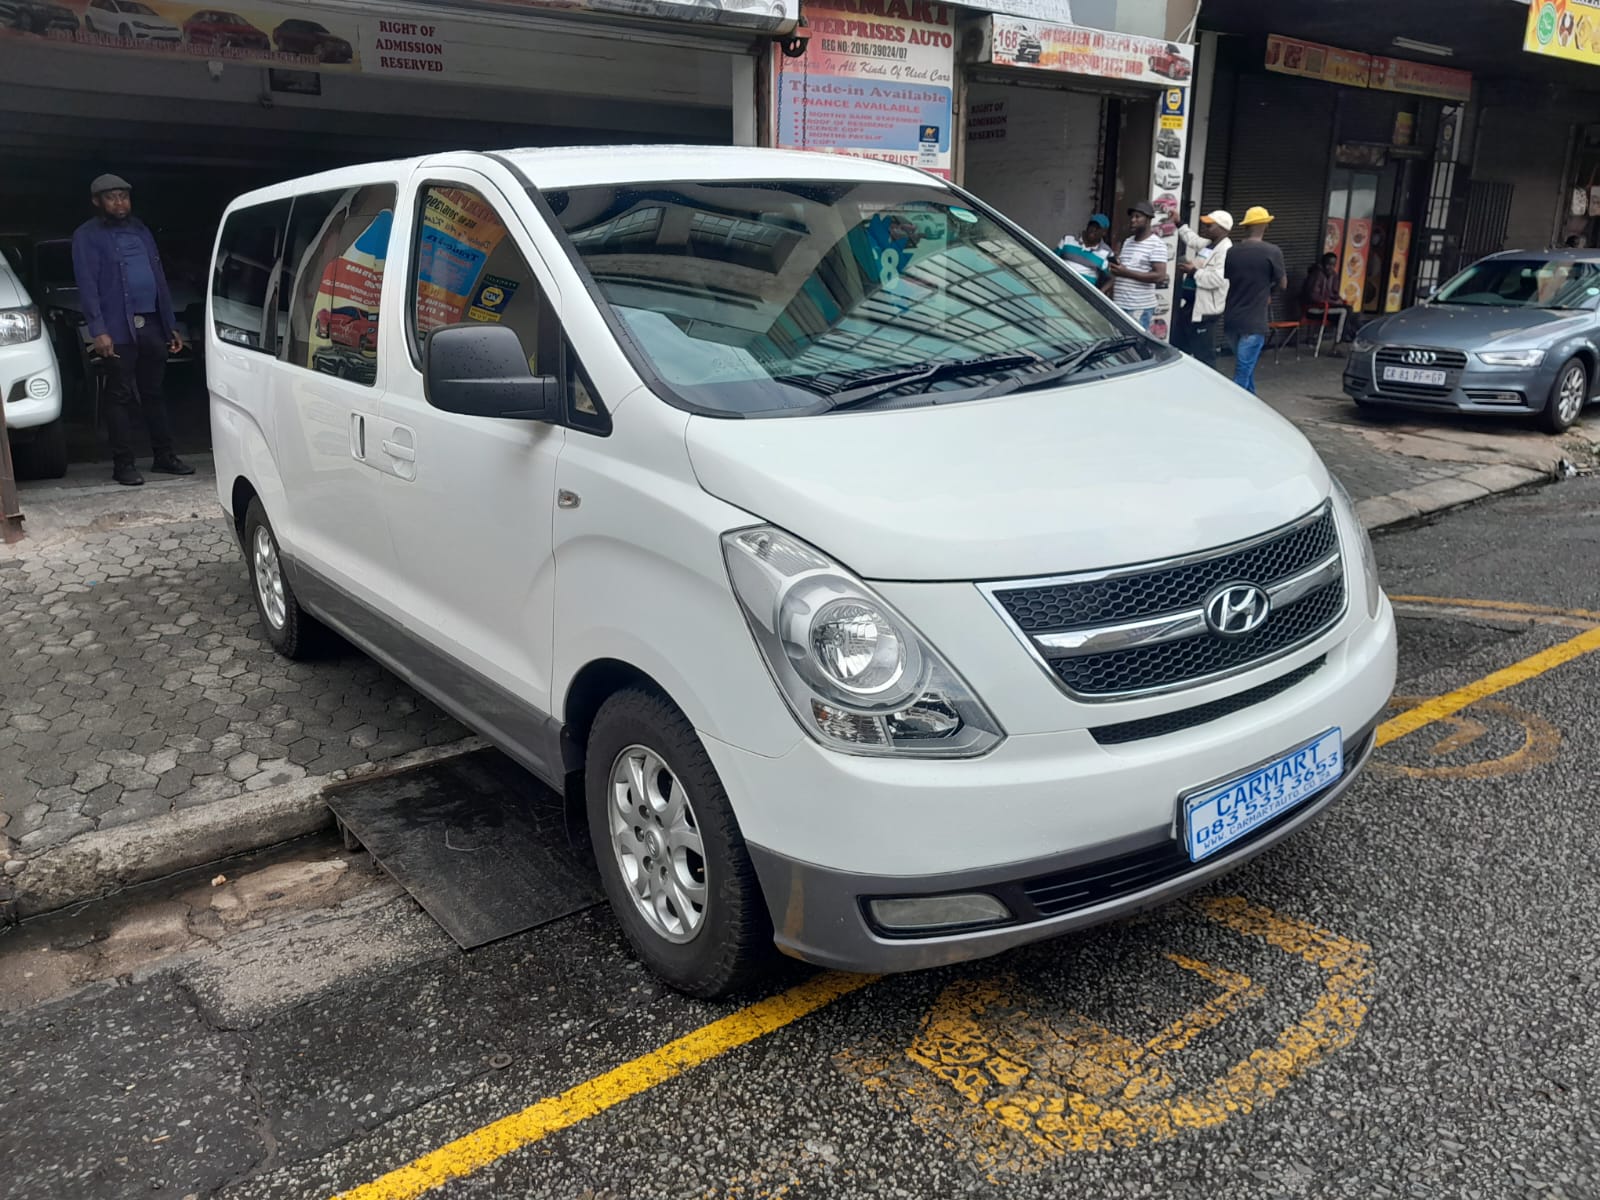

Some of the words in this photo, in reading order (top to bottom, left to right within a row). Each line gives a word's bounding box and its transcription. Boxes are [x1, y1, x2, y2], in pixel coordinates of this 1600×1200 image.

[379, 21, 418, 35] RIGHT
[420, 25, 435, 37] OF
[907, 27, 952, 48] AUTO
[376, 38, 442, 55] ADMISSION
[821, 38, 836, 51] REG
[999, 29, 1018, 48] 168
[381, 56, 443, 72] RESERVED
[860, 61, 887, 75] Kinds
[890, 64, 902, 79] Of
[905, 66, 928, 79] Used
[930, 69, 951, 82] Cars
[870, 87, 947, 103] Available
[854, 101, 920, 113] AVAILABLE
[1216, 743, 1321, 817] CARMART
[1196, 809, 1239, 844] 083
[1245, 784, 1285, 816] 533
[1291, 752, 1338, 790] 3653
